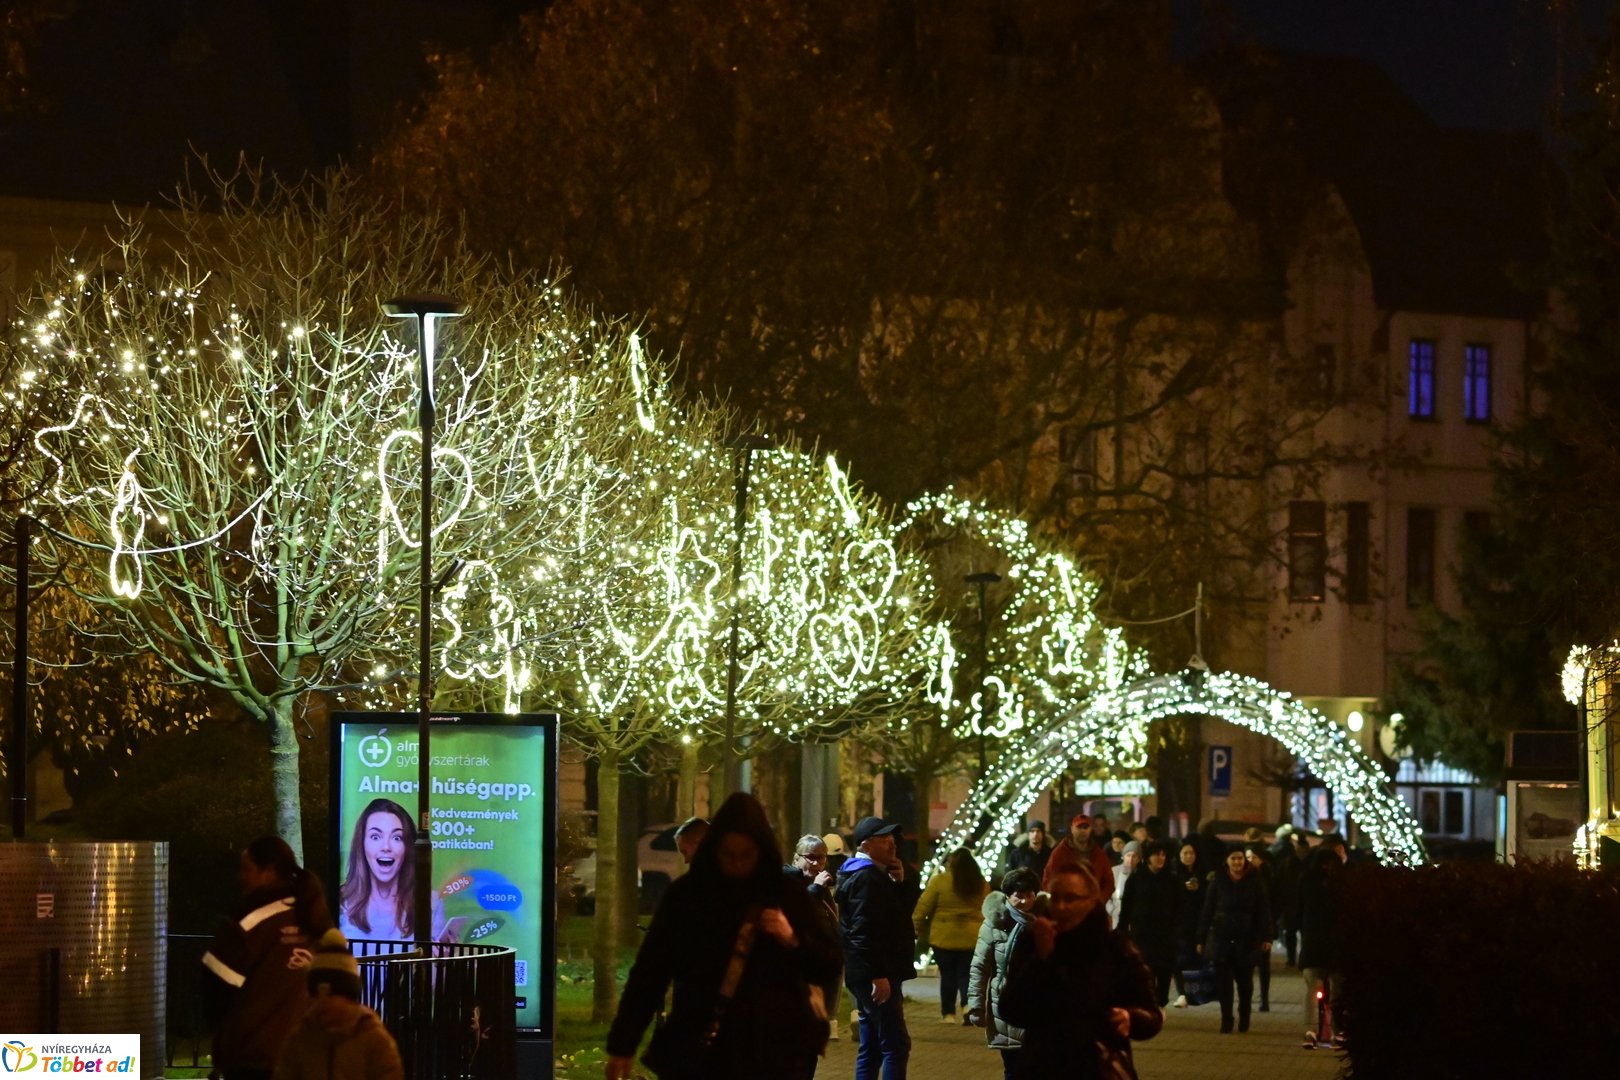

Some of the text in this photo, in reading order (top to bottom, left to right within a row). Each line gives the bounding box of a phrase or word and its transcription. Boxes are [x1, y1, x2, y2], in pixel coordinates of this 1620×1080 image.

[396, 739, 420, 752] alm
[396, 752, 490, 768] gyóyszertárak
[1212, 749, 1227, 780] P
[431, 776, 537, 801] hűségapp.
[431, 807, 519, 822] Kedvezmények
[431, 821, 475, 836] 300+
[431, 839, 494, 851] patikában!
[442, 877, 470, 896] -30%
[481, 894, 517, 902] -1500 Ft
[470, 920, 498, 939] -25%
